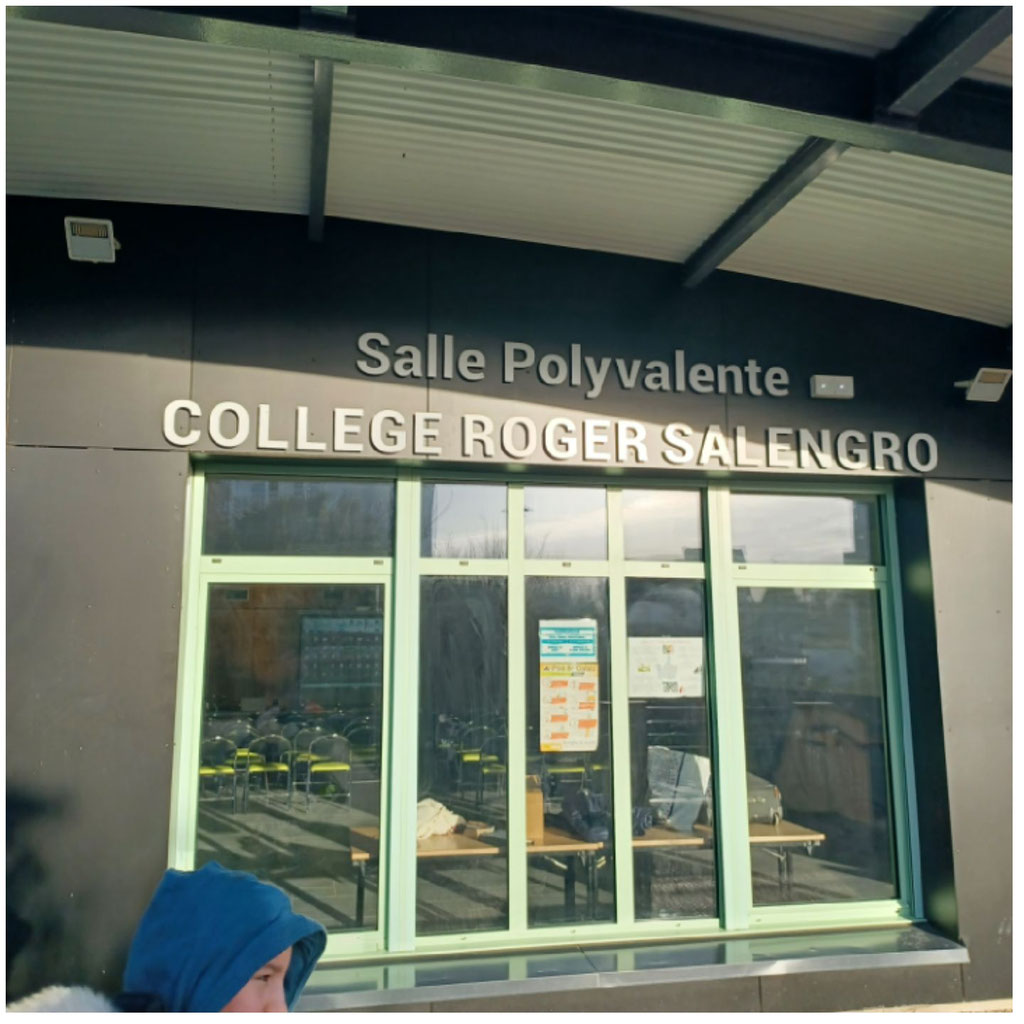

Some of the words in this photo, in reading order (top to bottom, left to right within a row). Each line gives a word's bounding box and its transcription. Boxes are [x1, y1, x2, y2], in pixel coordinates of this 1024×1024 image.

[356, 332, 486, 380] Salle
[503, 341, 790, 399] Polyvalente
[162, 399, 443, 455] COLLEGE
[462, 413, 648, 463] ROGER
[661, 423, 939, 473] SALENGRO
